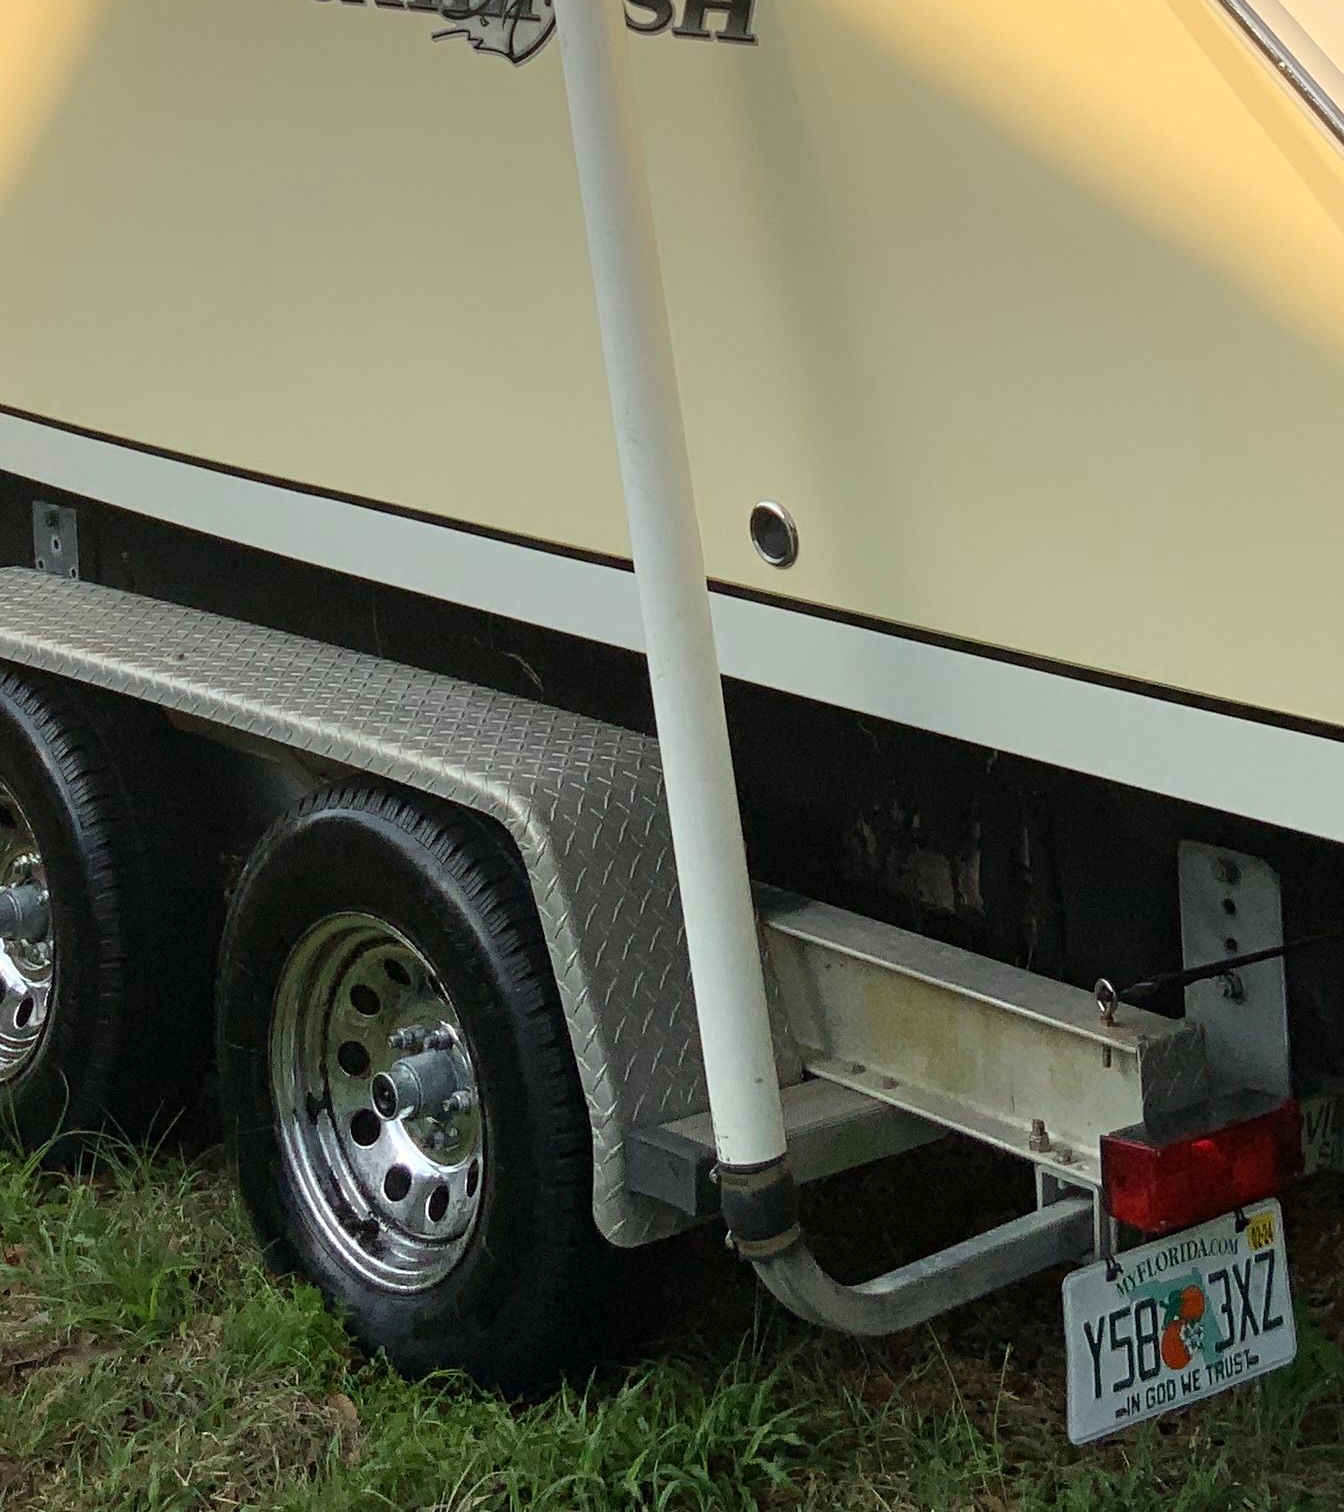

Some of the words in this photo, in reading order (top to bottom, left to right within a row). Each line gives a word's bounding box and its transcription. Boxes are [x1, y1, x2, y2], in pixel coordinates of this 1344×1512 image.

[1115, 1237, 1239, 1297] MYFLORIDA.COM
[1208, 1249, 1284, 1353] 3XZ
[1126, 1392, 1141, 1417] IN
[1145, 1378, 1176, 1409] GOD
[1181, 1368, 1201, 1395] WE
[1206, 1349, 1250, 1386] TRUST
